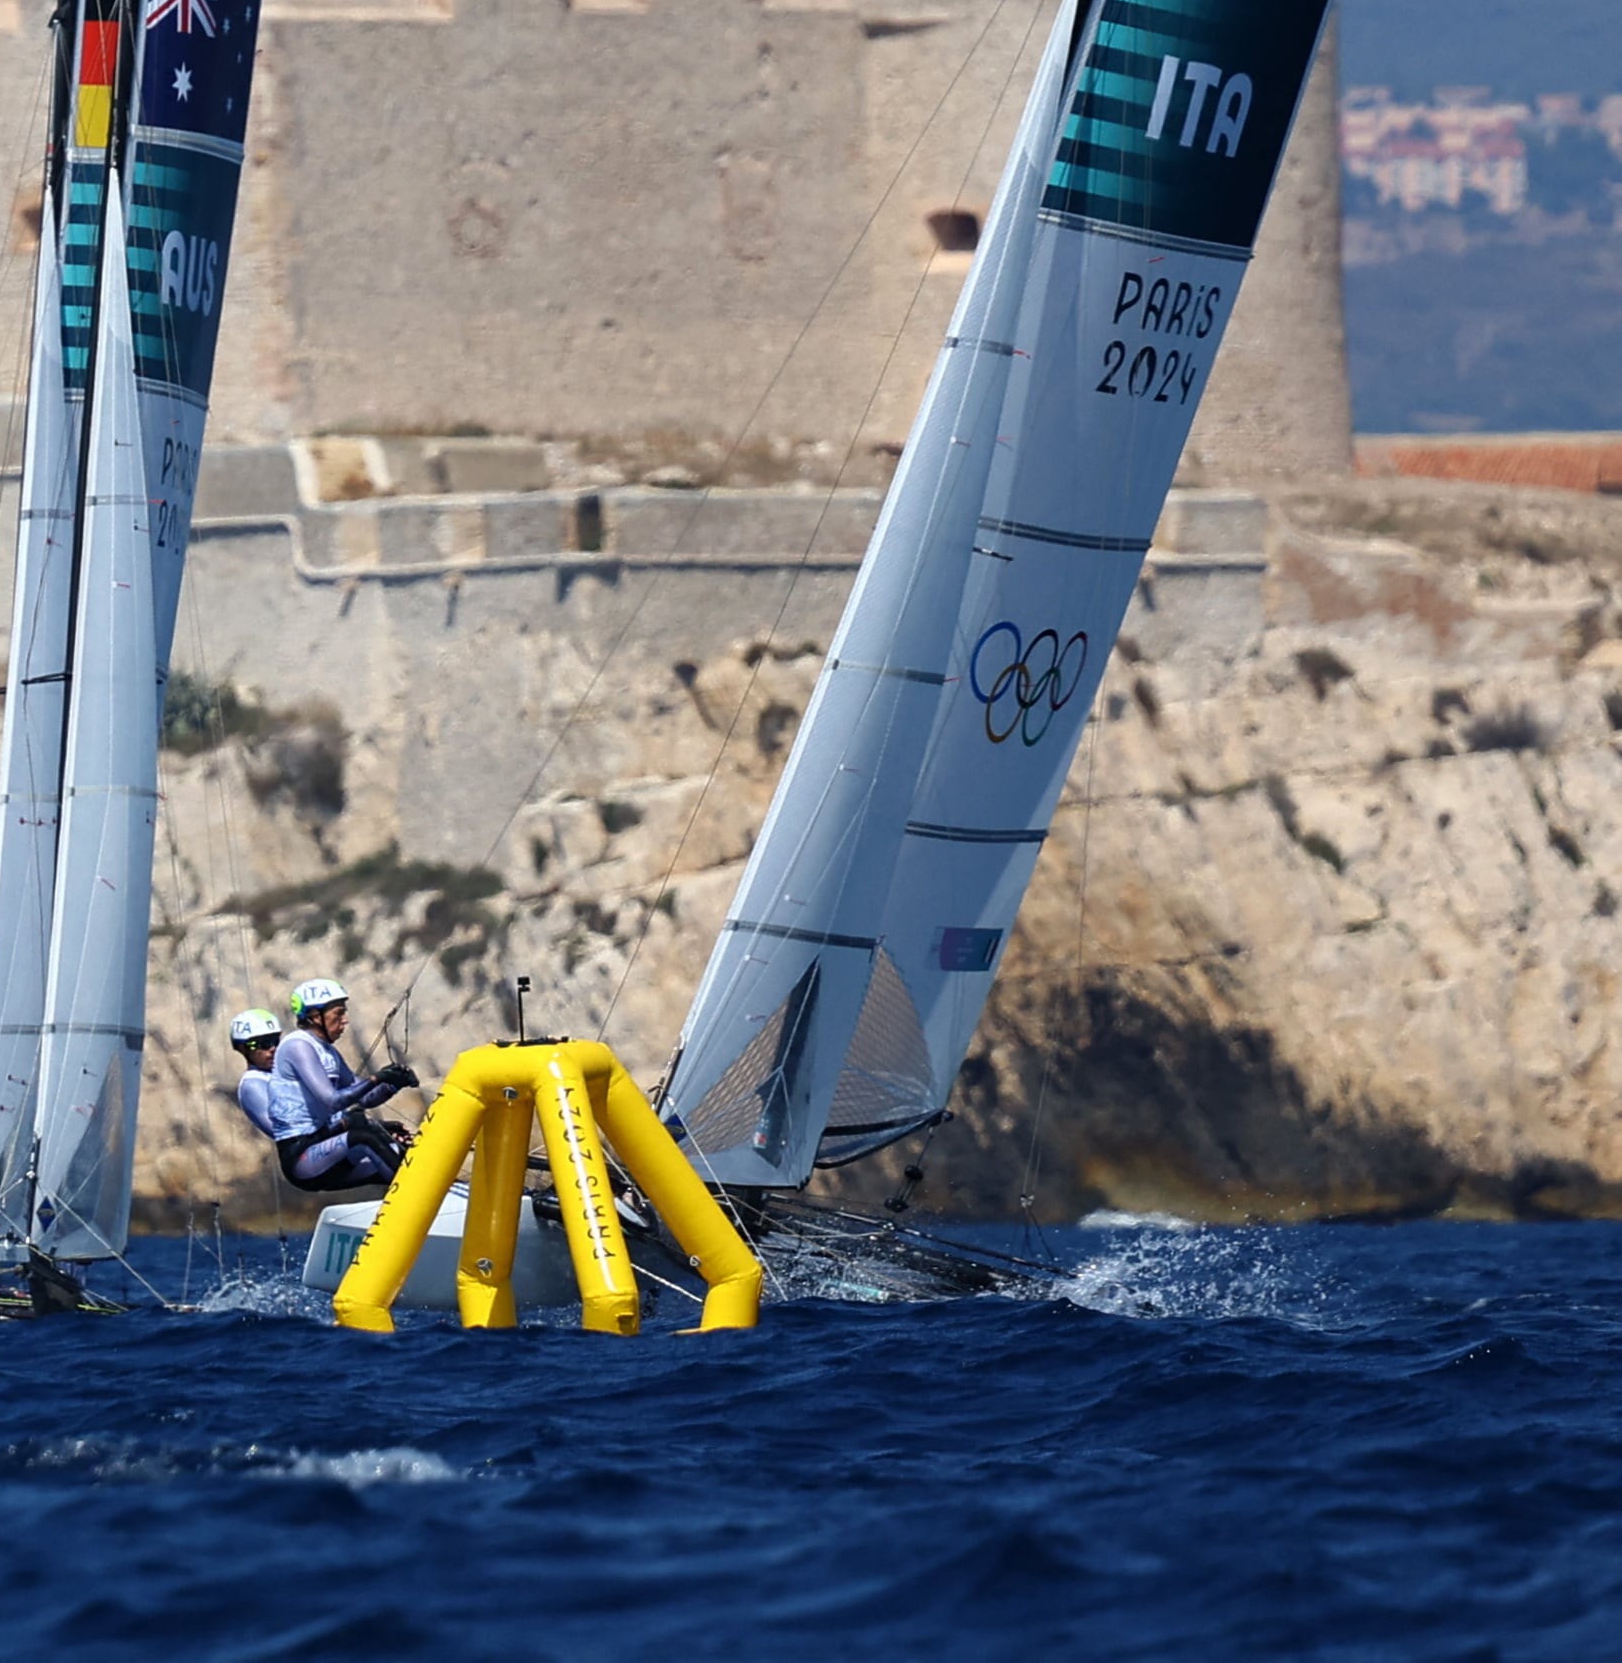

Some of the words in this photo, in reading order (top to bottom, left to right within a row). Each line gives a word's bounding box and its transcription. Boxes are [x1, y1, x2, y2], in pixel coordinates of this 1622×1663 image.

[1145, 55, 1252, 157] ITA
[161, 230, 218, 317] AUS
[1095, 340, 1196, 405] 2024
[303, 985, 331, 1001] ITA
